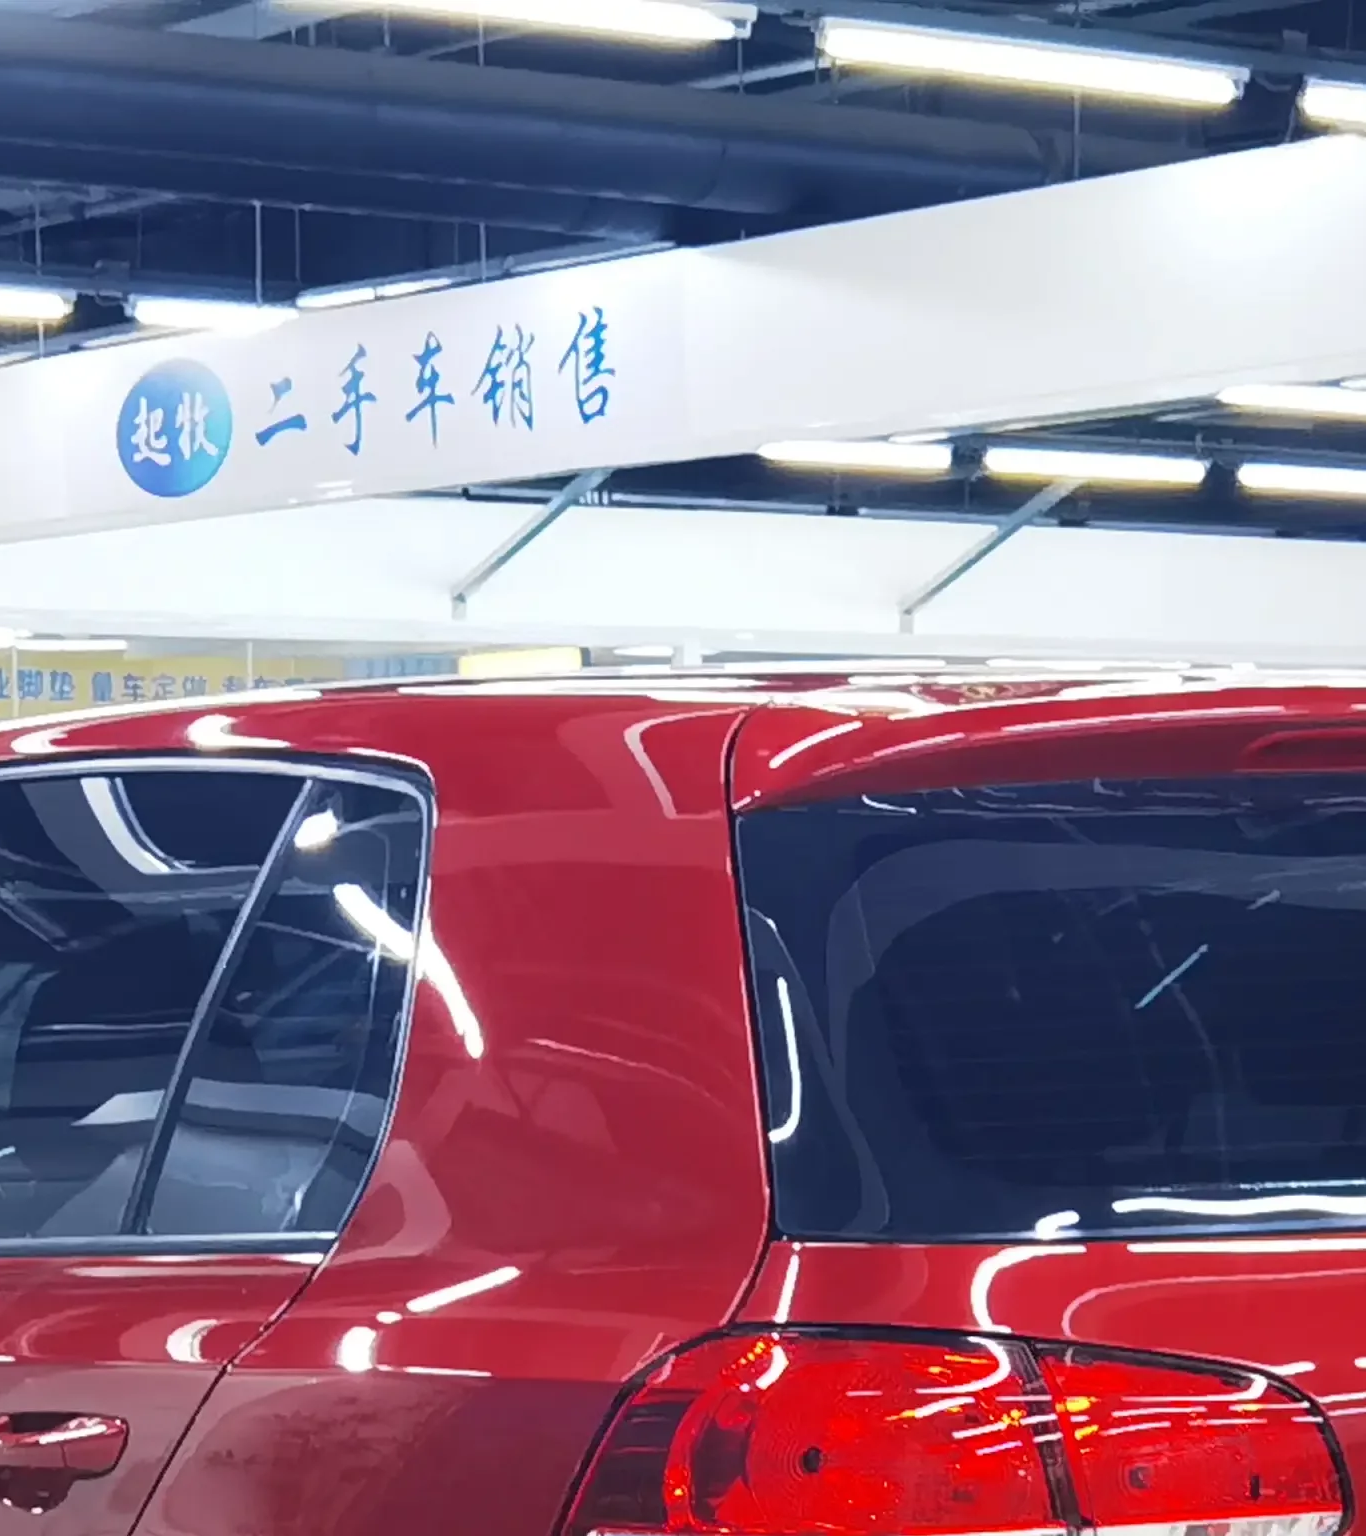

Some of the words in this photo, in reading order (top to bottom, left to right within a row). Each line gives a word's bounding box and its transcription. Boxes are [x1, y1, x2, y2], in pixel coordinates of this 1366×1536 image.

[130, 391, 220, 467] 起牧
[254, 305, 616, 456] 二手车销售
